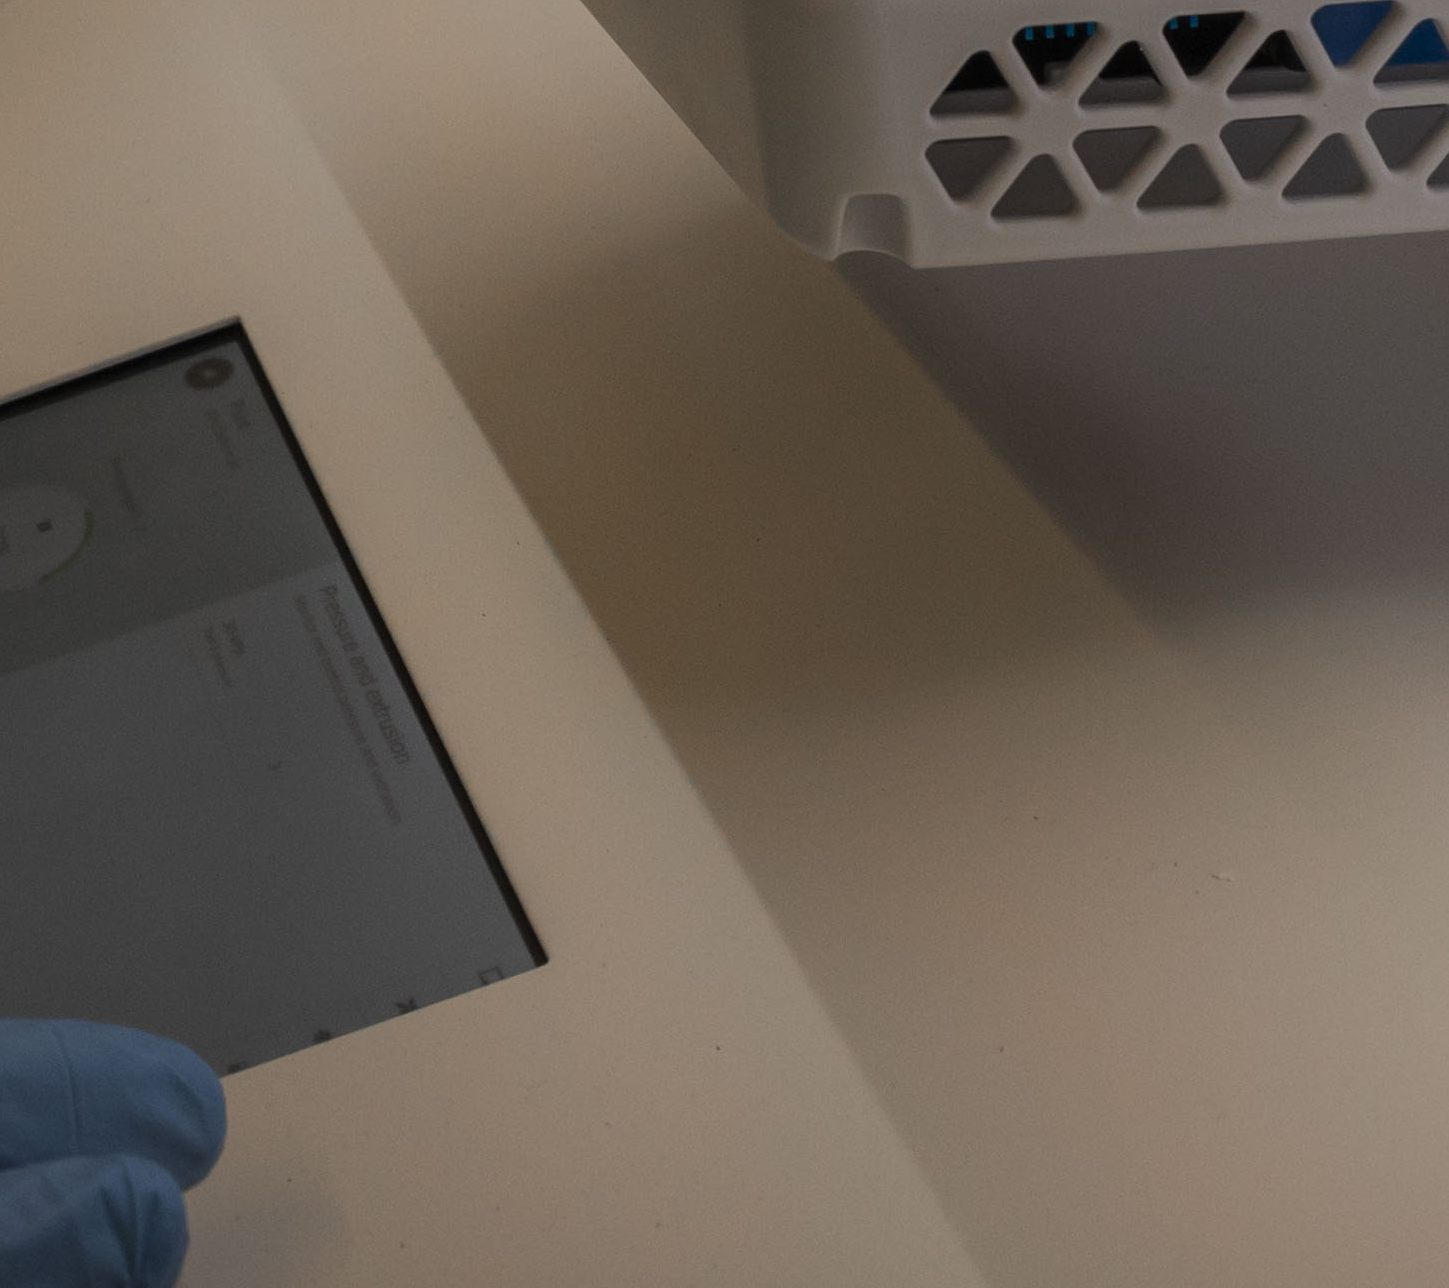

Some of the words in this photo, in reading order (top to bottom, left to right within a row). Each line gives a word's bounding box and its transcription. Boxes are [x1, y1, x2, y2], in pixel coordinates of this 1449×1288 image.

[318, 583, 360, 652] Pressure
[348, 653, 376, 688] and
[362, 686, 412, 767] extrusion
